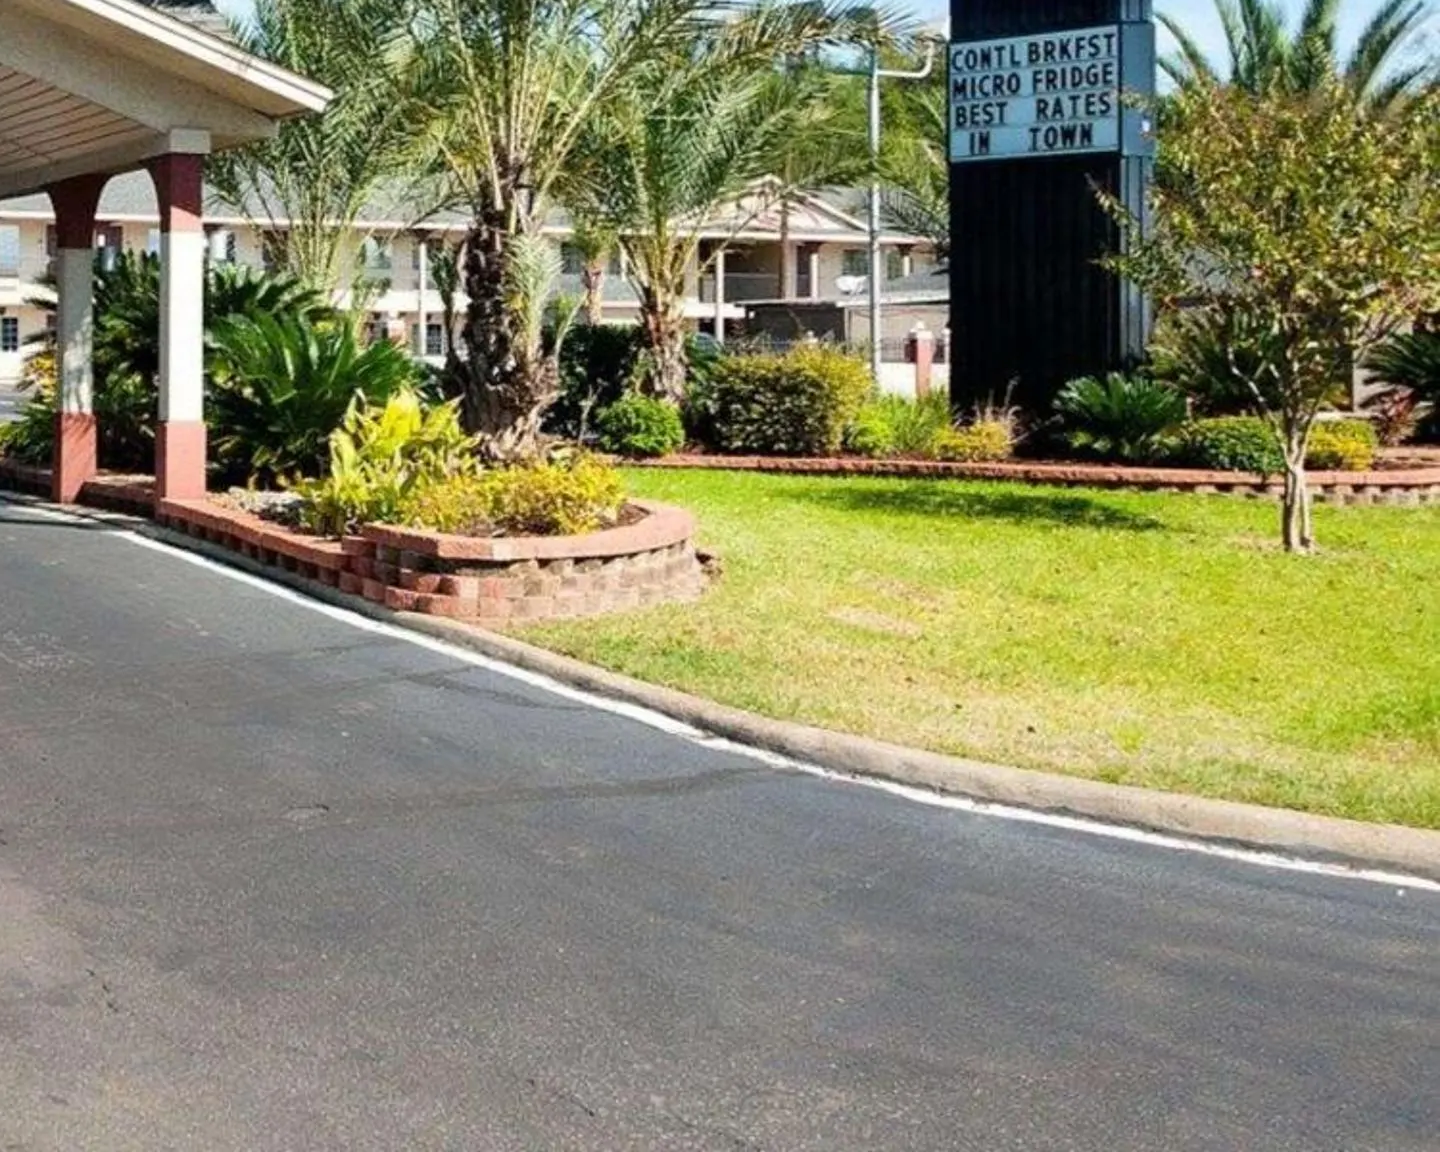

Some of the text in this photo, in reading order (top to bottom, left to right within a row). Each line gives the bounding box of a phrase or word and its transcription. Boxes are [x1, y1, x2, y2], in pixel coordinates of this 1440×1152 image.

[951, 34, 1115, 72] CONTL BRKFST
[952, 63, 1114, 100] MICRO FRIDGE
[955, 92, 1111, 128] BEST RATES
[969, 123, 1093, 155] IN TOWN
